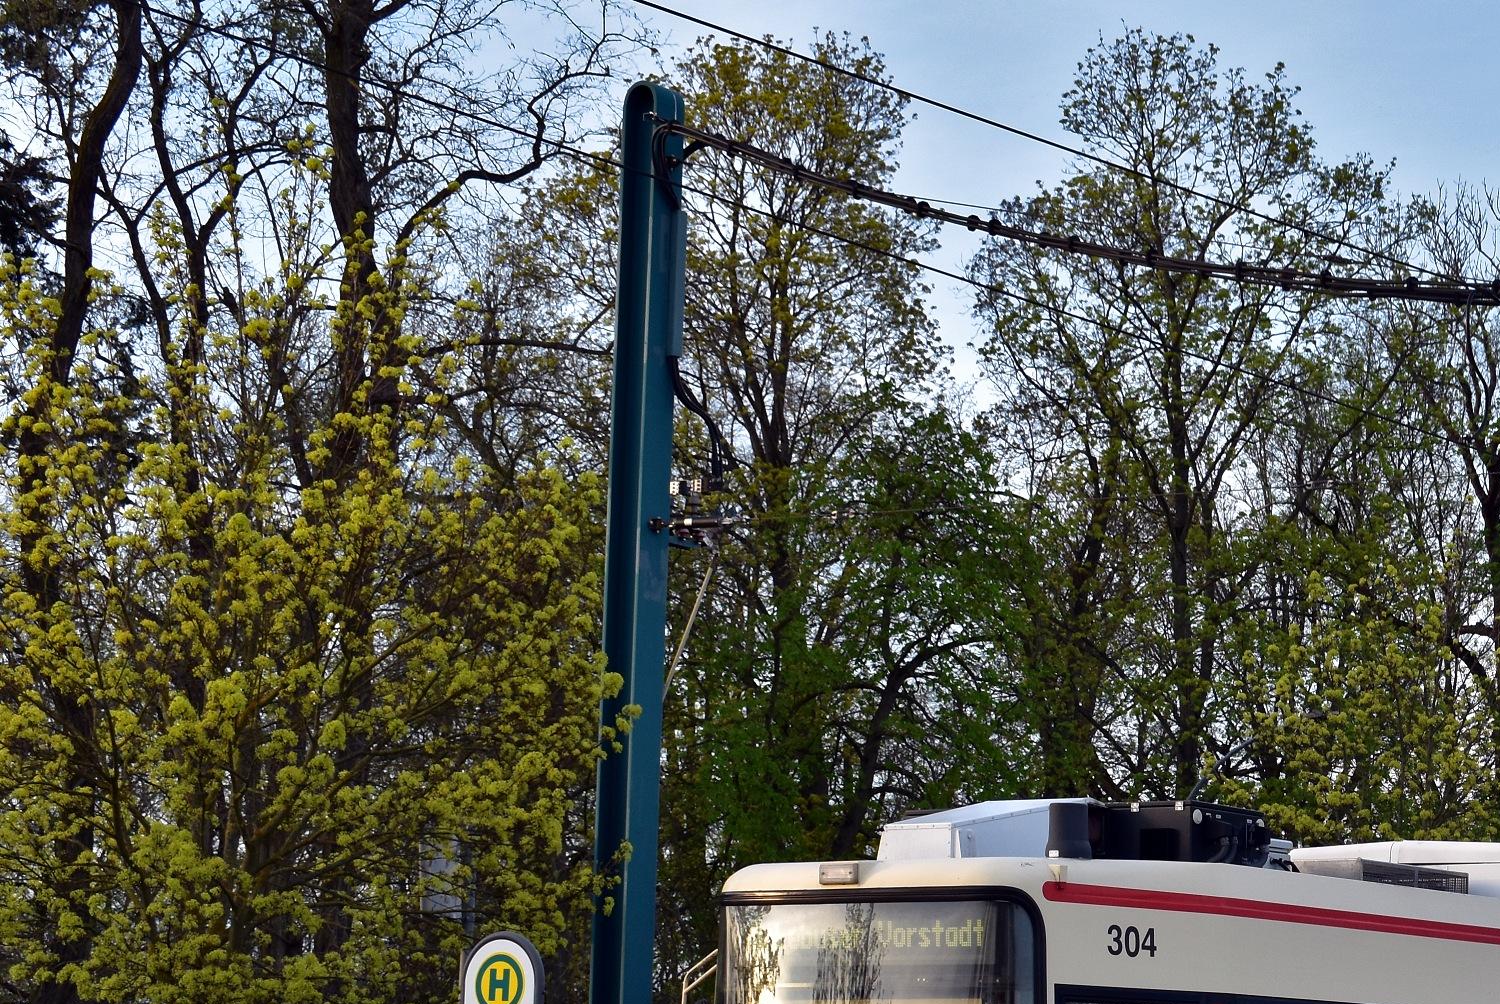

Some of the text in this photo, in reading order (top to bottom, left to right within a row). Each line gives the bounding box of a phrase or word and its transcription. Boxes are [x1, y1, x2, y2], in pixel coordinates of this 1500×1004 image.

[877, 919, 985, 948] Vorstadt
[1107, 924, 1157, 958] 304
[488, 968, 510, 1001] H
